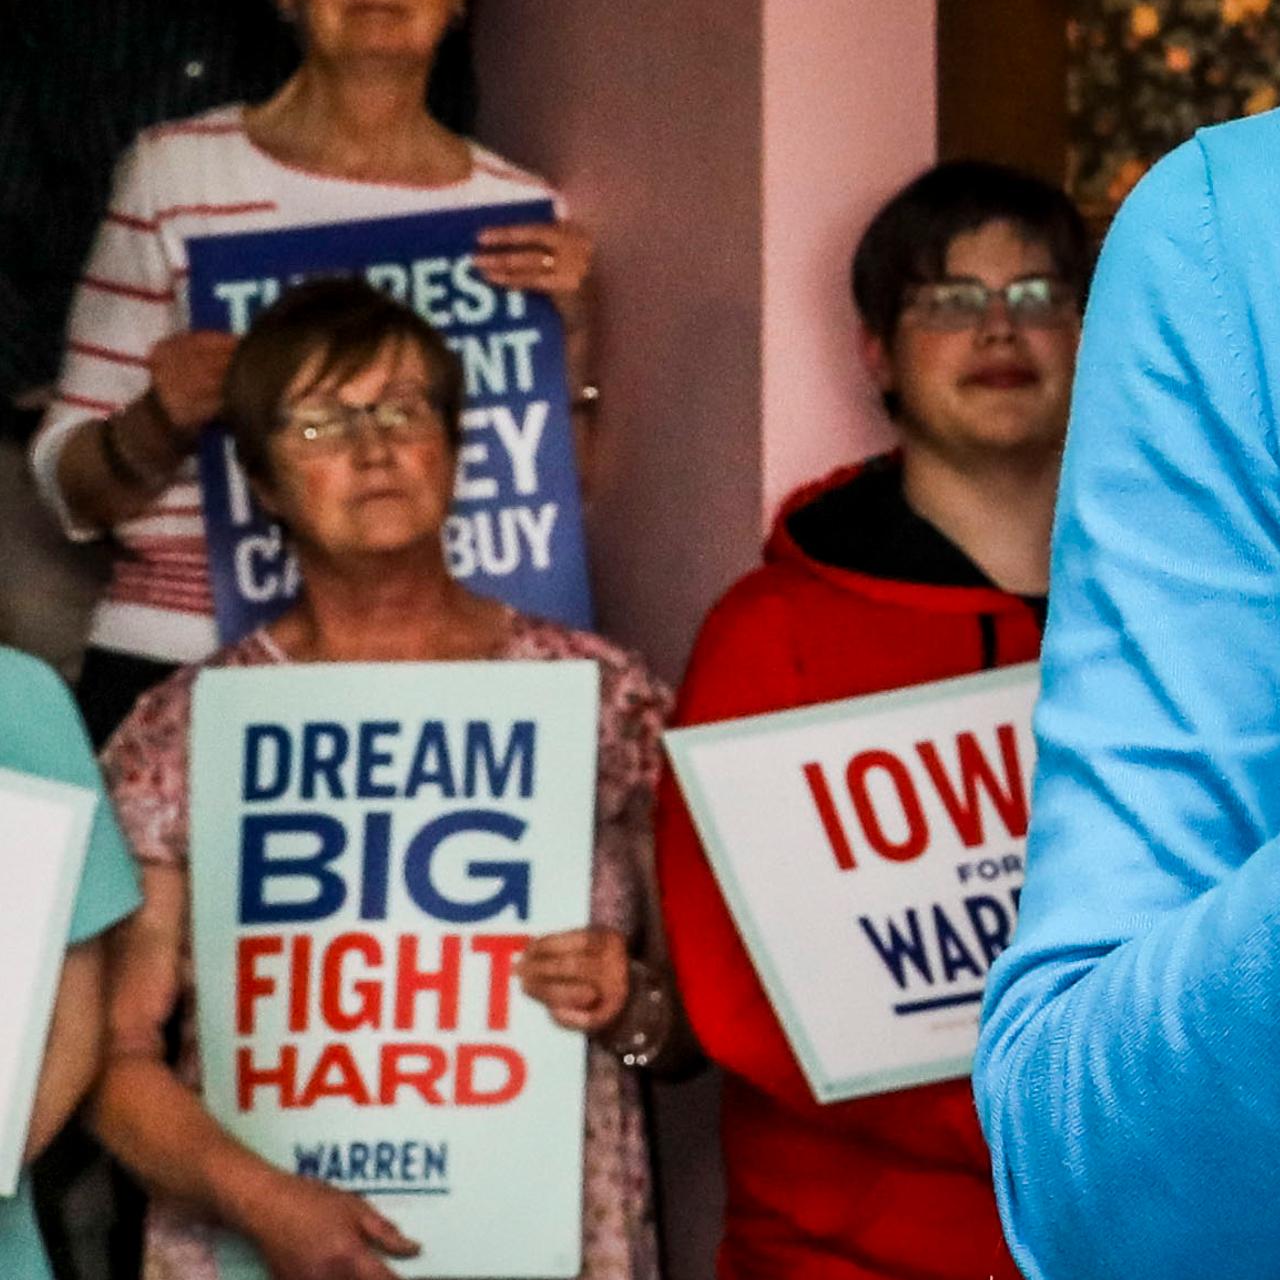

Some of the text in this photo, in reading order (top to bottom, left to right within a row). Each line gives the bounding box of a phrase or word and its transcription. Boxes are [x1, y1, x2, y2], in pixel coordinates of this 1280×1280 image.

[441, 503, 558, 578] BUY
[243, 720, 537, 801] DREAM
[802, 723, 1028, 871] IOW
[238, 810, 531, 923] BIG
[236, 933, 530, 1035] FIGHT
[858, 888, 1021, 989] WAR
[237, 1043, 526, 1111] HARD
[295, 1141, 449, 1182] WARREN
